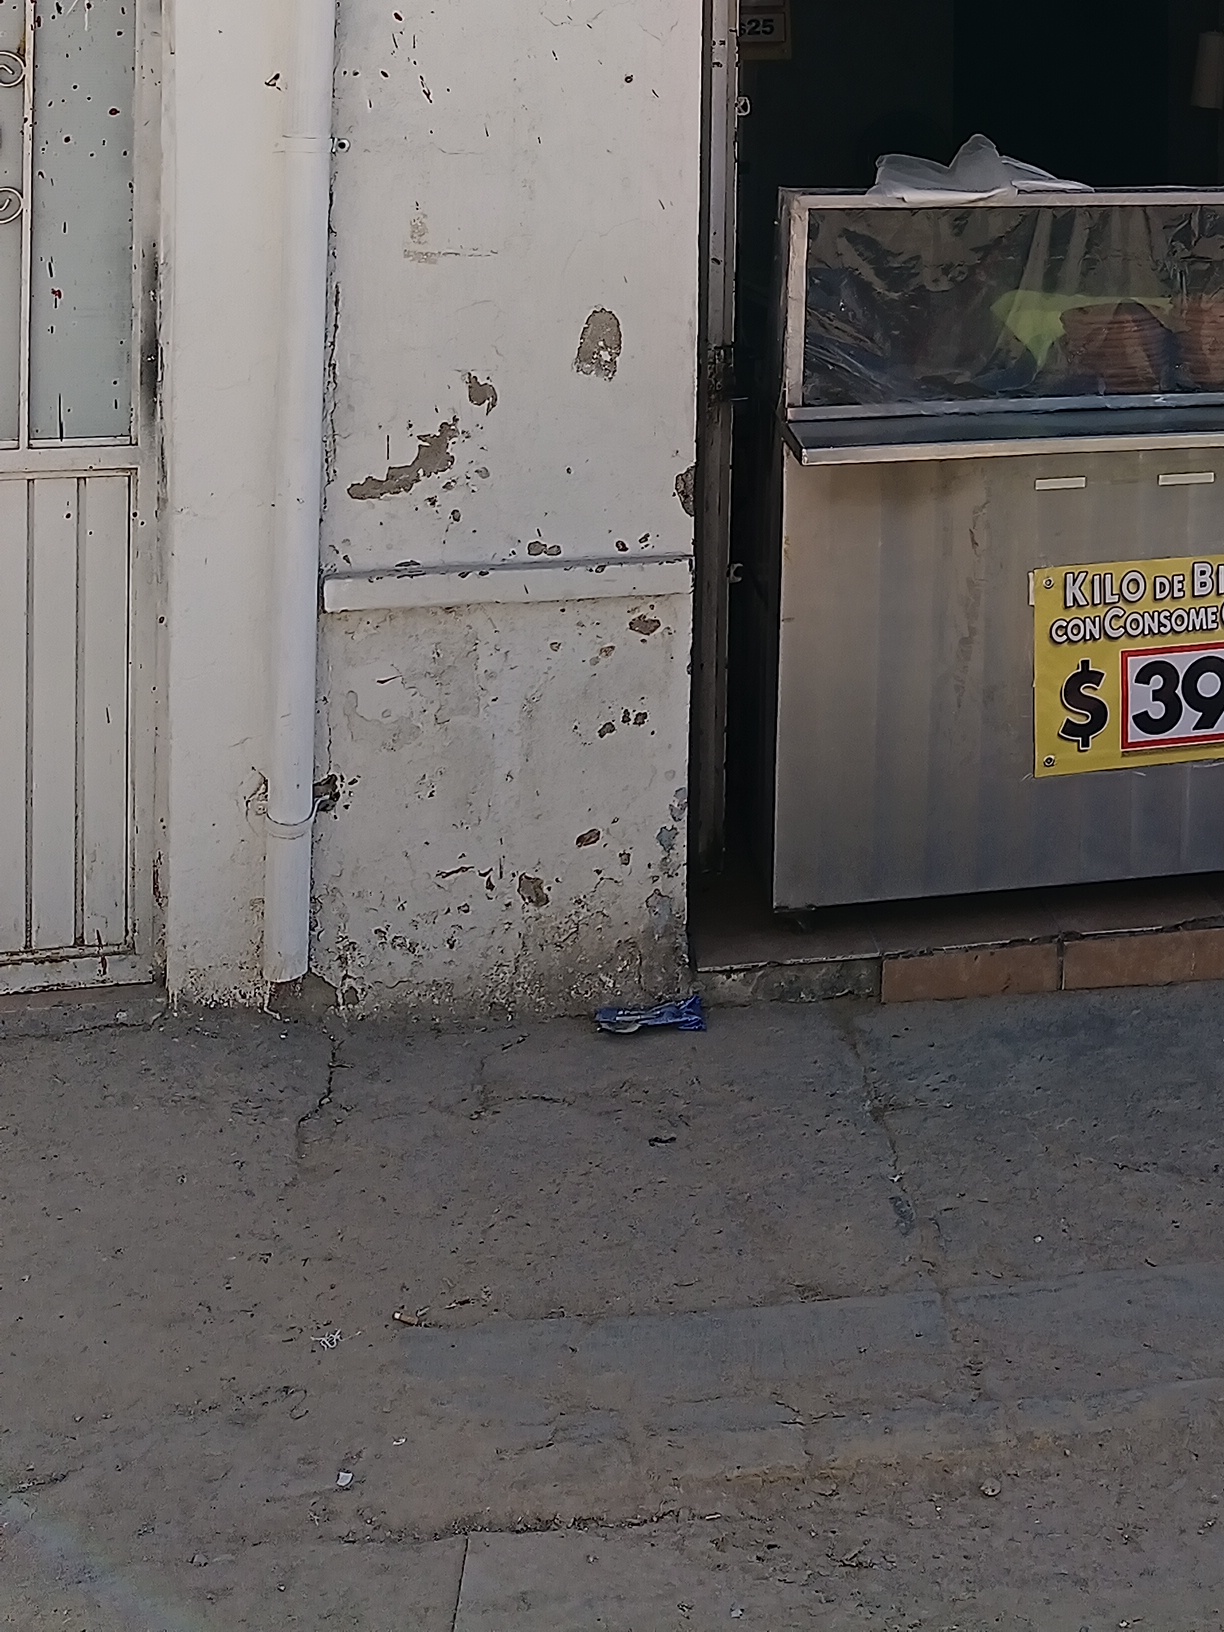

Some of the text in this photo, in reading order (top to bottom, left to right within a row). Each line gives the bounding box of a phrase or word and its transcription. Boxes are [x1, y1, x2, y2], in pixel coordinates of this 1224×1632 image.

[1064, 570, 1146, 609] KILO
[1153, 574, 1186, 602] DE
[1050, 616, 1101, 643] CON
[1103, 606, 1219, 639] CONSOME
